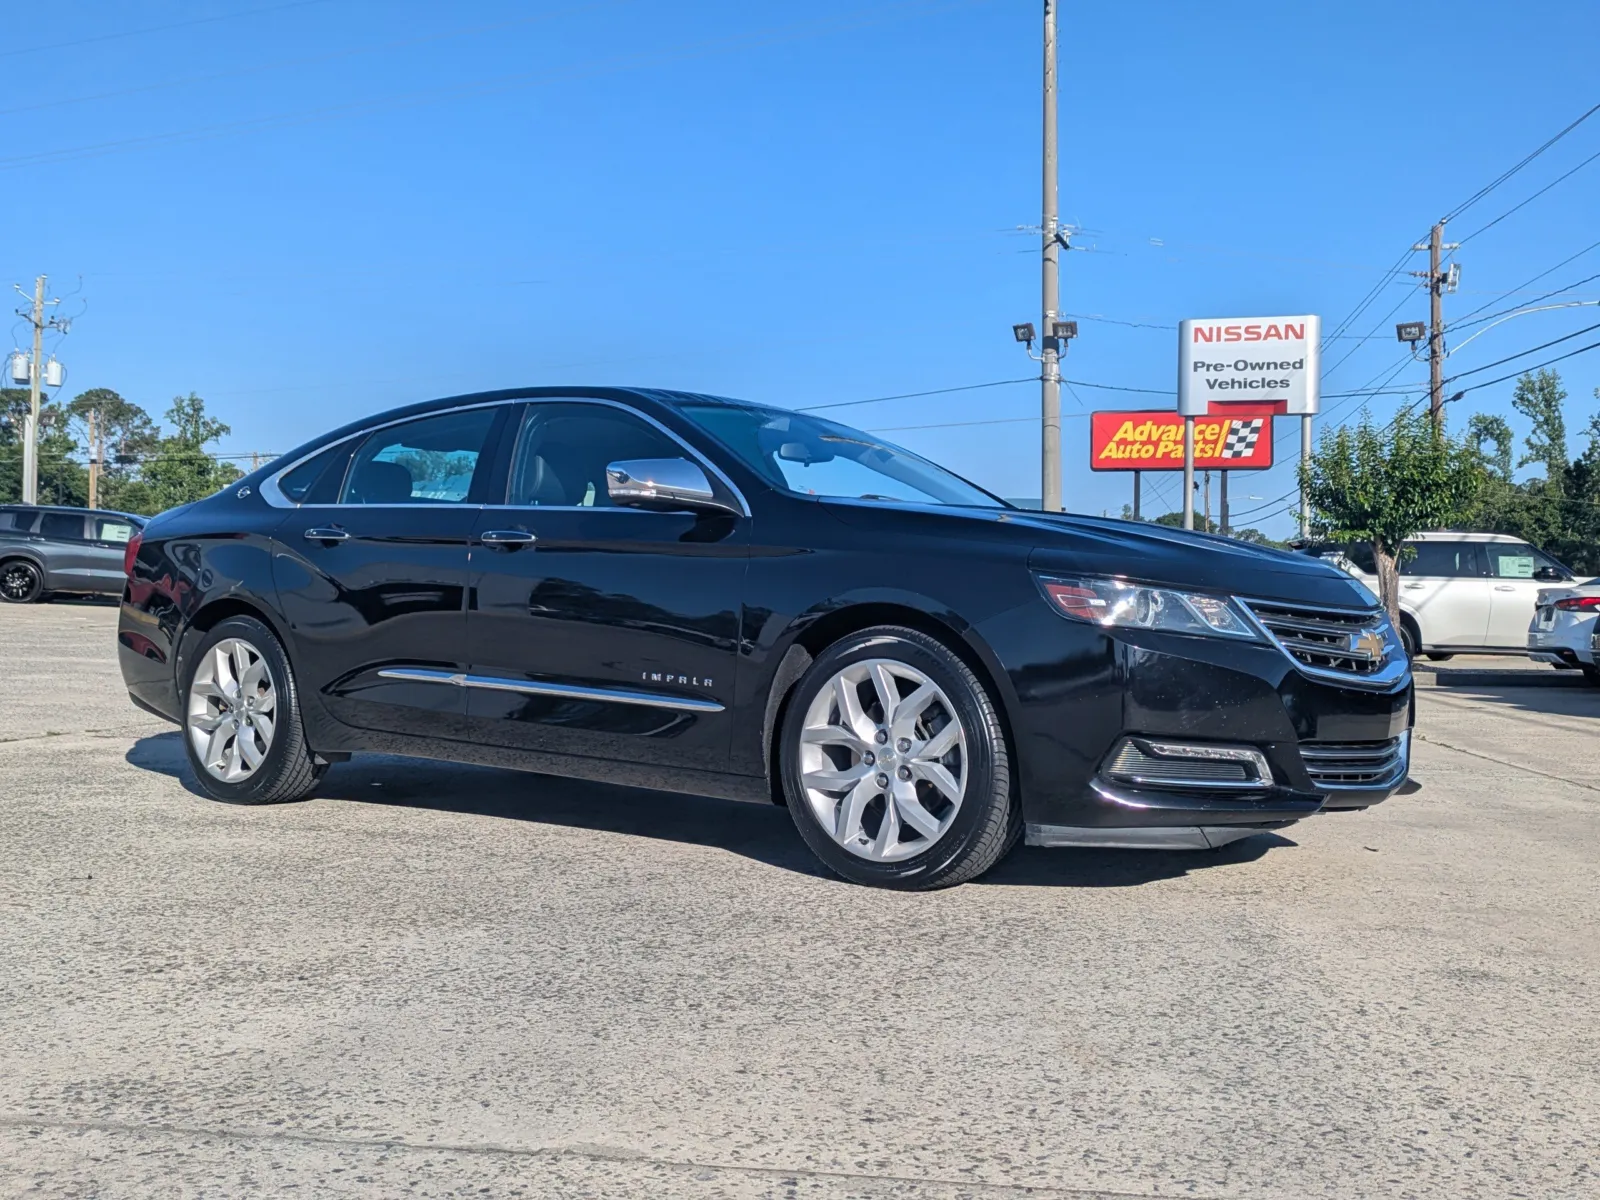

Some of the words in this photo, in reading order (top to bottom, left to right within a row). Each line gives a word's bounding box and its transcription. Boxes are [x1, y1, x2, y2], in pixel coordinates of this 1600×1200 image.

[1194, 324, 1304, 343] NISSAN
[1193, 359, 1304, 372] Pre-Owned
[1206, 377, 1290, 389] Vehicles
[1099, 441, 1154, 459] Auto
[1155, 441, 1215, 459] Pats
[642, 672, 713, 687] IMPALA
